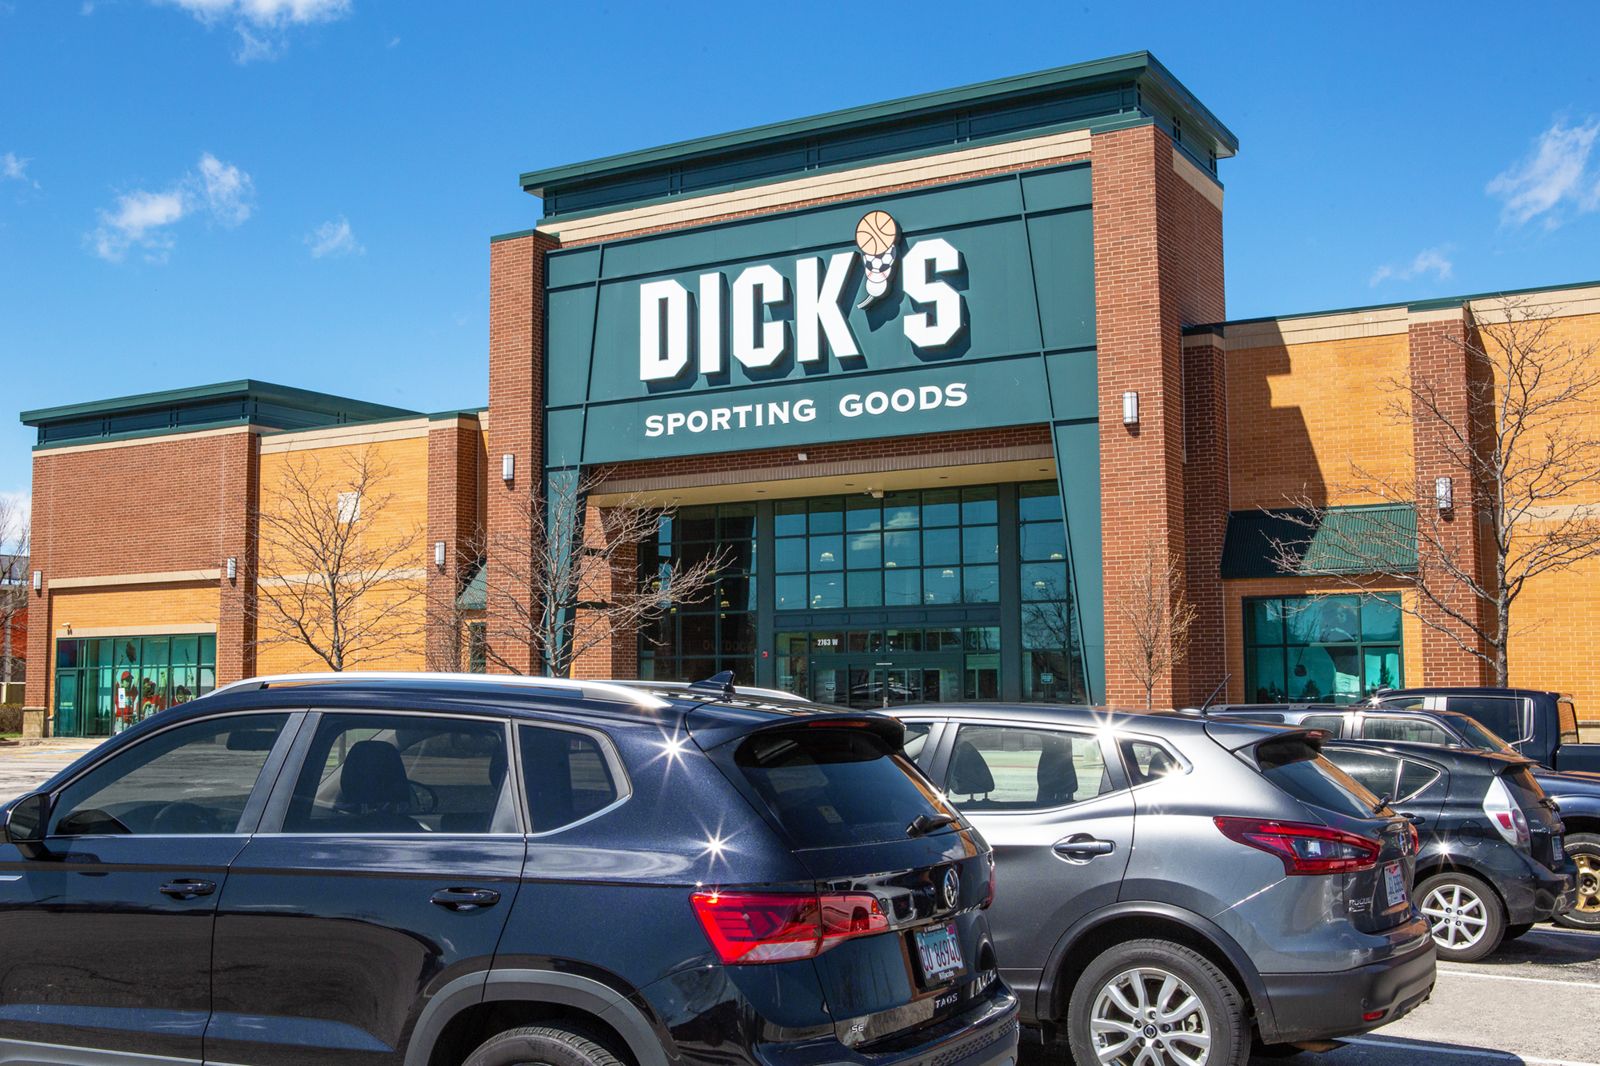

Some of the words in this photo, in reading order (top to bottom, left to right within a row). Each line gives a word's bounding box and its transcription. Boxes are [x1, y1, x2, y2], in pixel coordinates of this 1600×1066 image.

[640, 210, 961, 381] DICK'S
[645, 398, 817, 438] SPORTING
[839, 382, 968, 419] GOODS
[935, 993, 958, 1008] TAOS
[851, 1023, 864, 1033] SE
